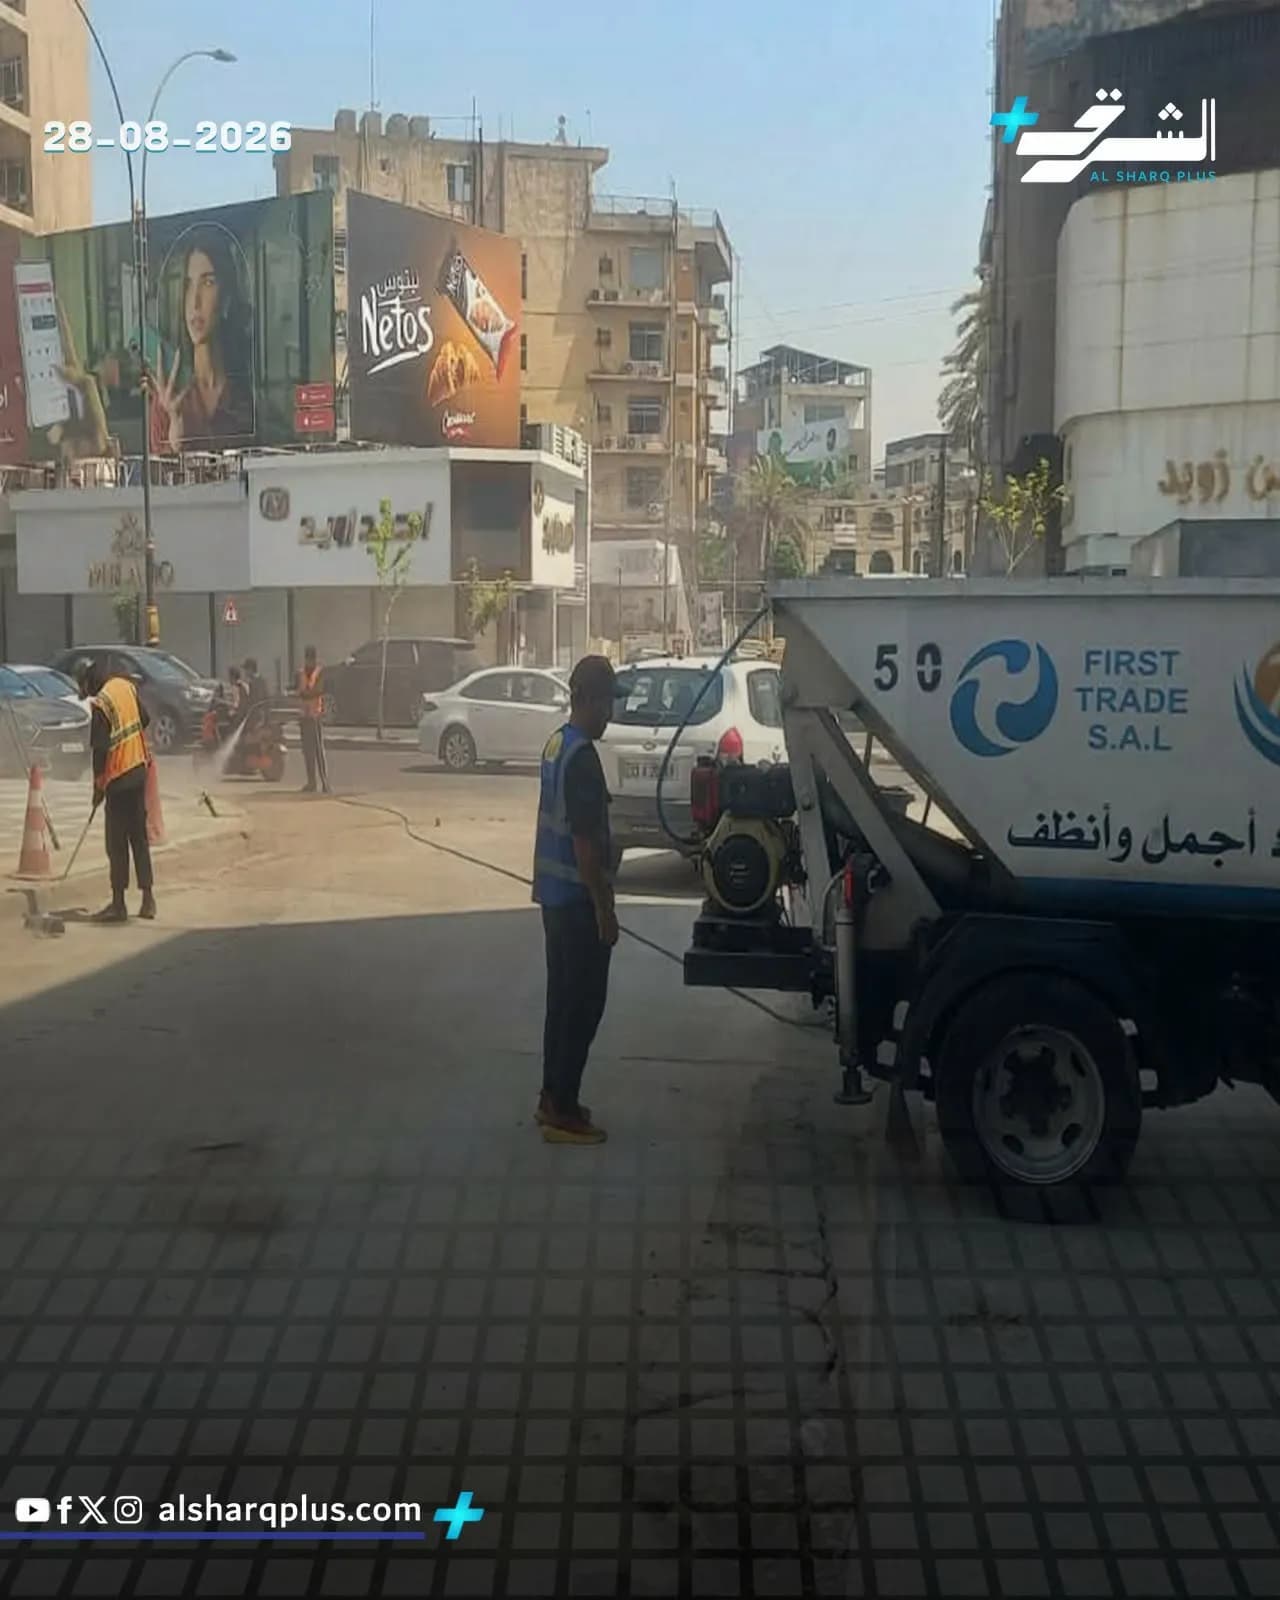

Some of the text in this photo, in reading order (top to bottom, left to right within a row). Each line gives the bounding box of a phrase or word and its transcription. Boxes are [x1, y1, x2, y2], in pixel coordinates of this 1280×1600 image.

[361, 286, 434, 358] Netos
[1084, 649, 1181, 678] FIRST
[1073, 686, 1190, 715] TRADE
[1087, 724, 1173, 752] S.A.L
[1006, 803, 1133, 863] وأنظف
[1141, 806, 1257, 868] أجمل
